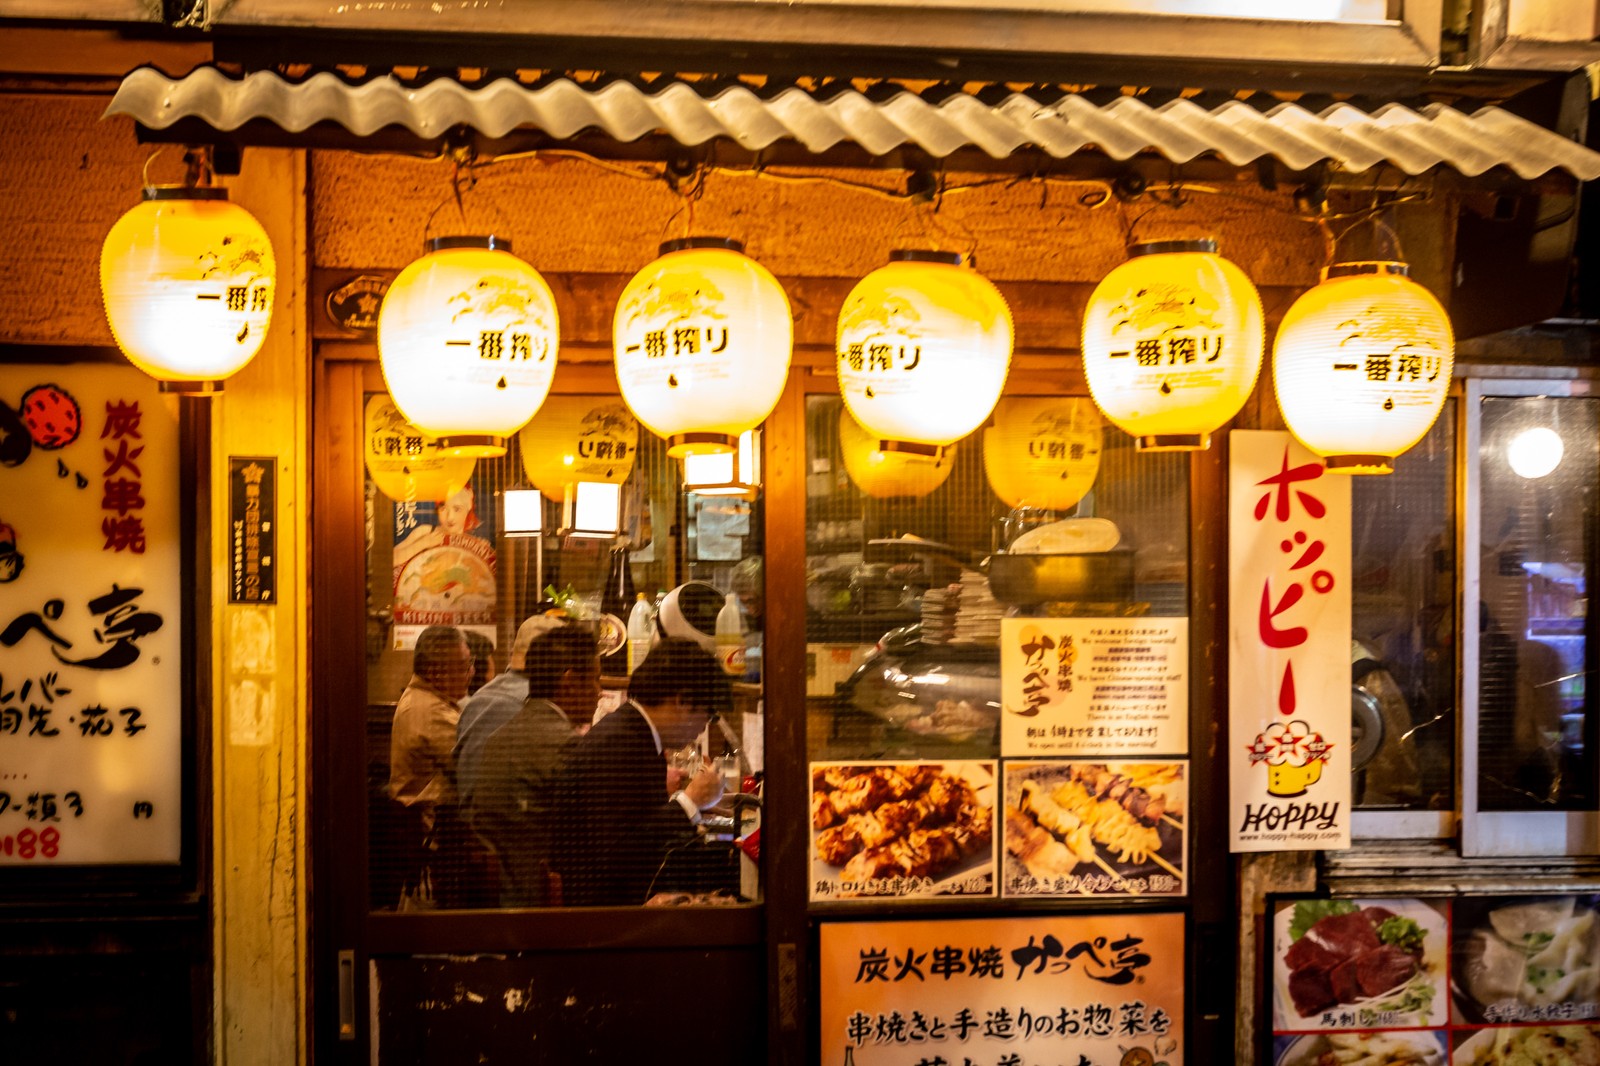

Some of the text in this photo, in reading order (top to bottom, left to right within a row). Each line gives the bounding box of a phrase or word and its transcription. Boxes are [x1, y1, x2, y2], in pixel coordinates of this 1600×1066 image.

[446, 332, 548, 361] 一番搾り
[625, 328, 729, 357] 一番搾り
[1110, 337, 1222, 366] 一番搾り
[1334, 354, 1441, 383] 一番搾り
[101, 399, 145, 555] 炭火串焼
[1253, 443, 1335, 716] ホッピー
[402, 611, 444, 625] KIRIN
[0, 826, 60, 859] 188
[854, 934, 1152, 985] 炭火串焼 かっぺ亭
[847, 1001, 1171, 1047] 串焼きと手造りのお惣菜を
